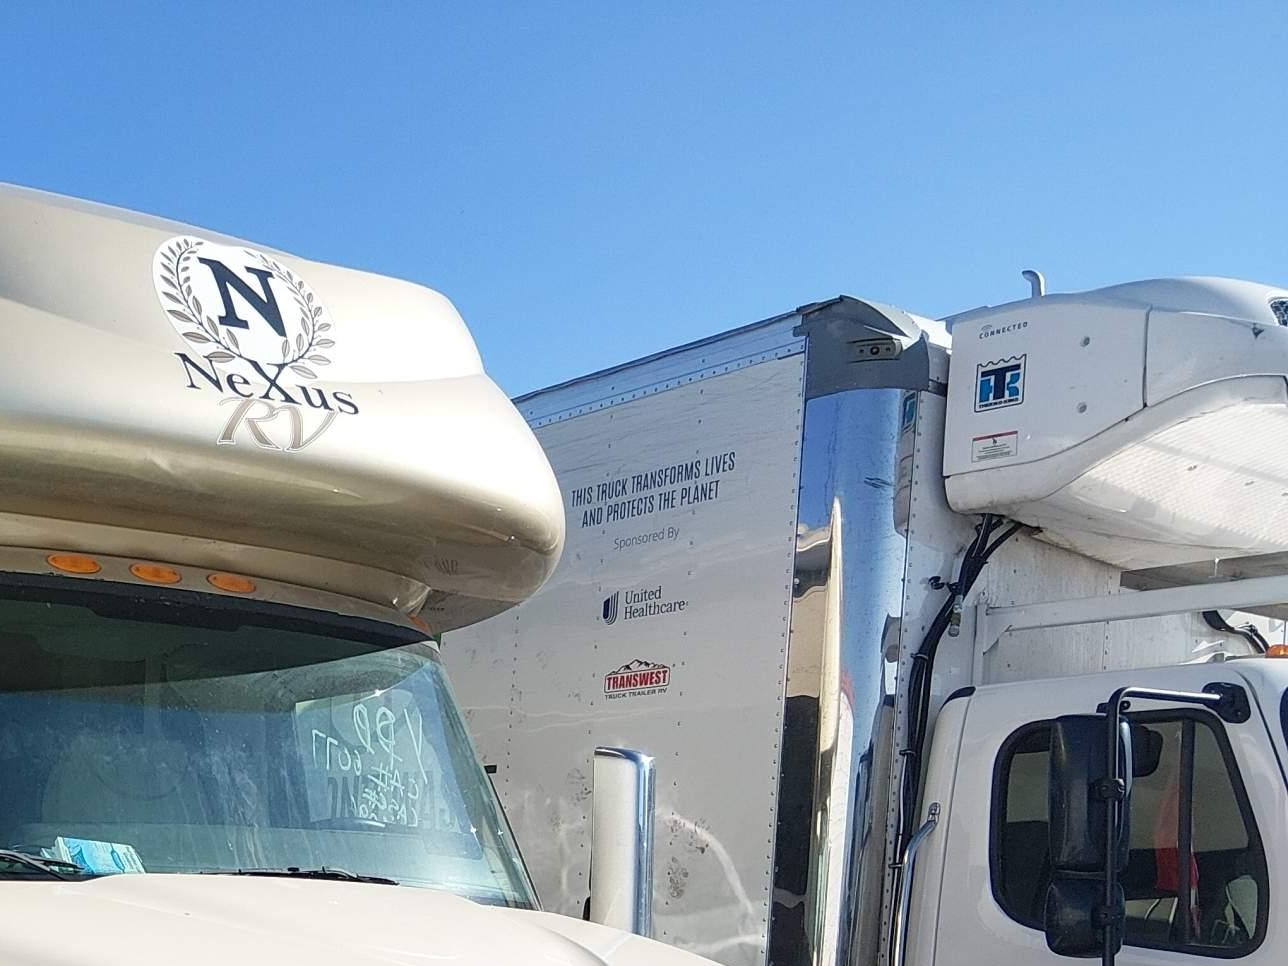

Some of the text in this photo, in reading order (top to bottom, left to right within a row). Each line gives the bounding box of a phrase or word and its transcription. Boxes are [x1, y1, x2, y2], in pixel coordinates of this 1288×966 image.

[197, 256, 287, 338] N
[978, 321, 1028, 339] CONNECTED
[217, 397, 339, 451] RV
[571, 451, 736, 507] THIS TRUCK TRANSFORMS LIVES
[582, 480, 721, 528] AND PROTECTS THE PLANET
[613, 526, 680, 550] Sponsored By
[625, 585, 662, 604] United
[606, 670, 668, 690] TRANSWEST
